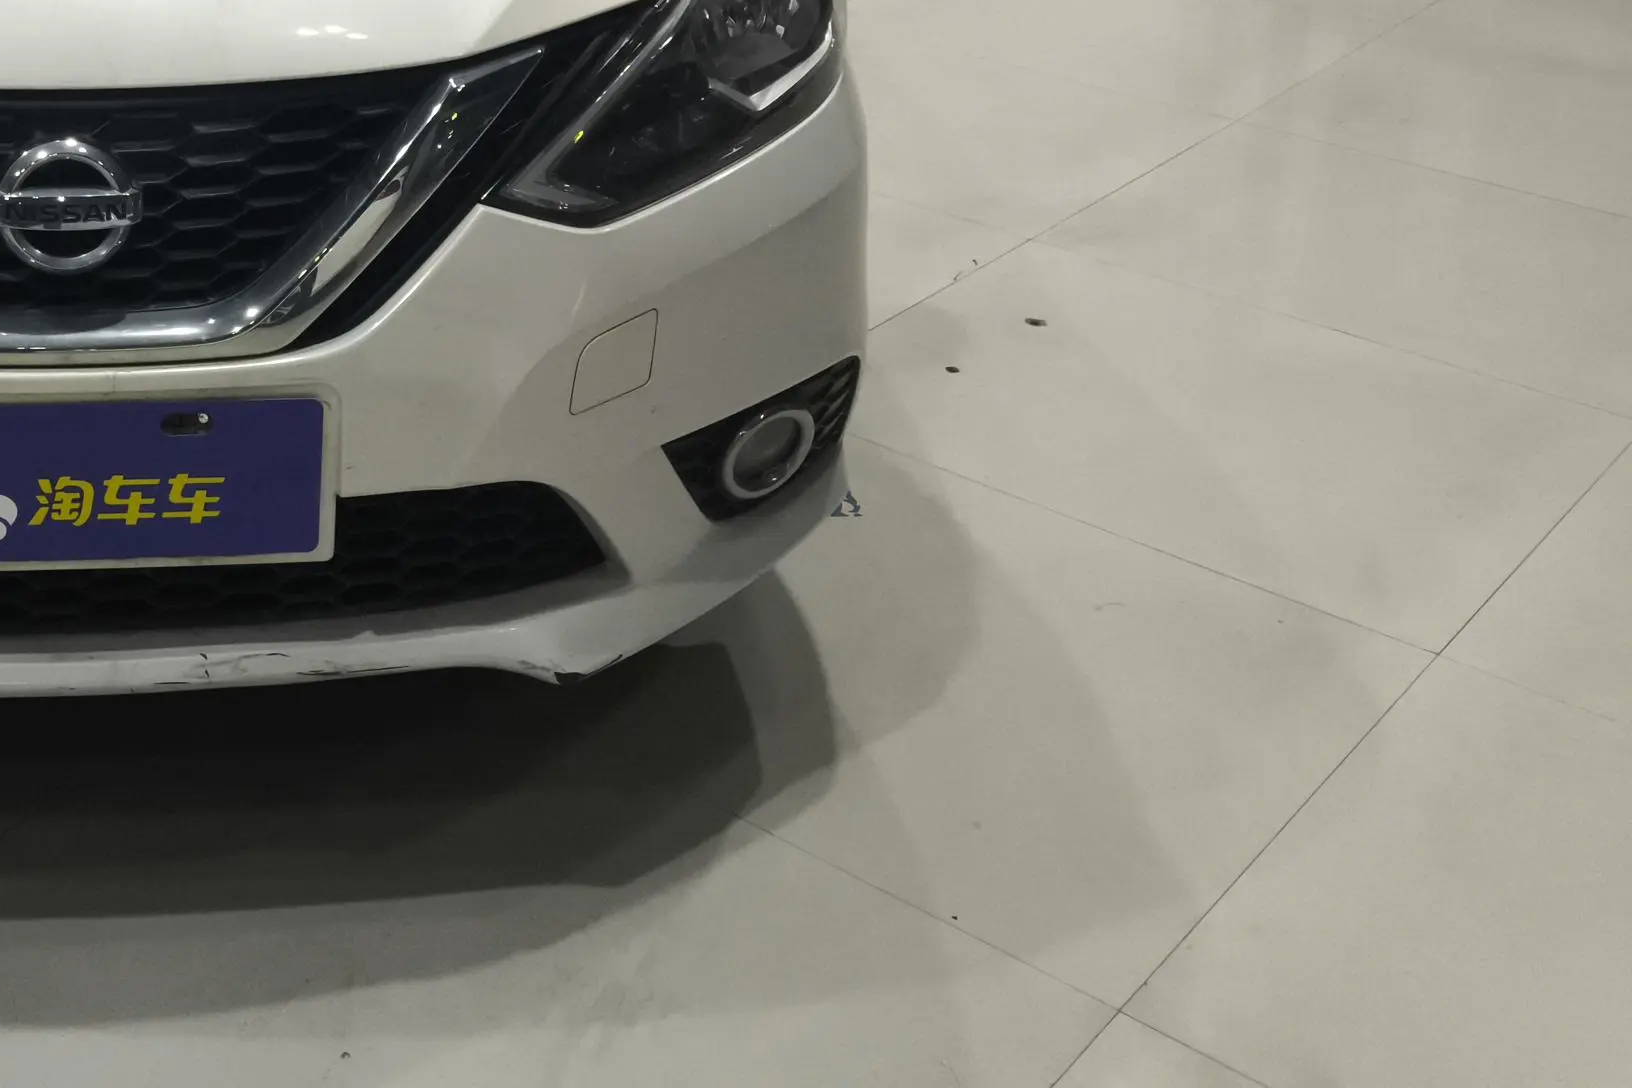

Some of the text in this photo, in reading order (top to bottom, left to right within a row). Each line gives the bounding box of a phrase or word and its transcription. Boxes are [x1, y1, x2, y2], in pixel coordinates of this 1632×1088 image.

[5, 202, 128, 223] NISSAN
[29, 473, 225, 526] 淘车车
